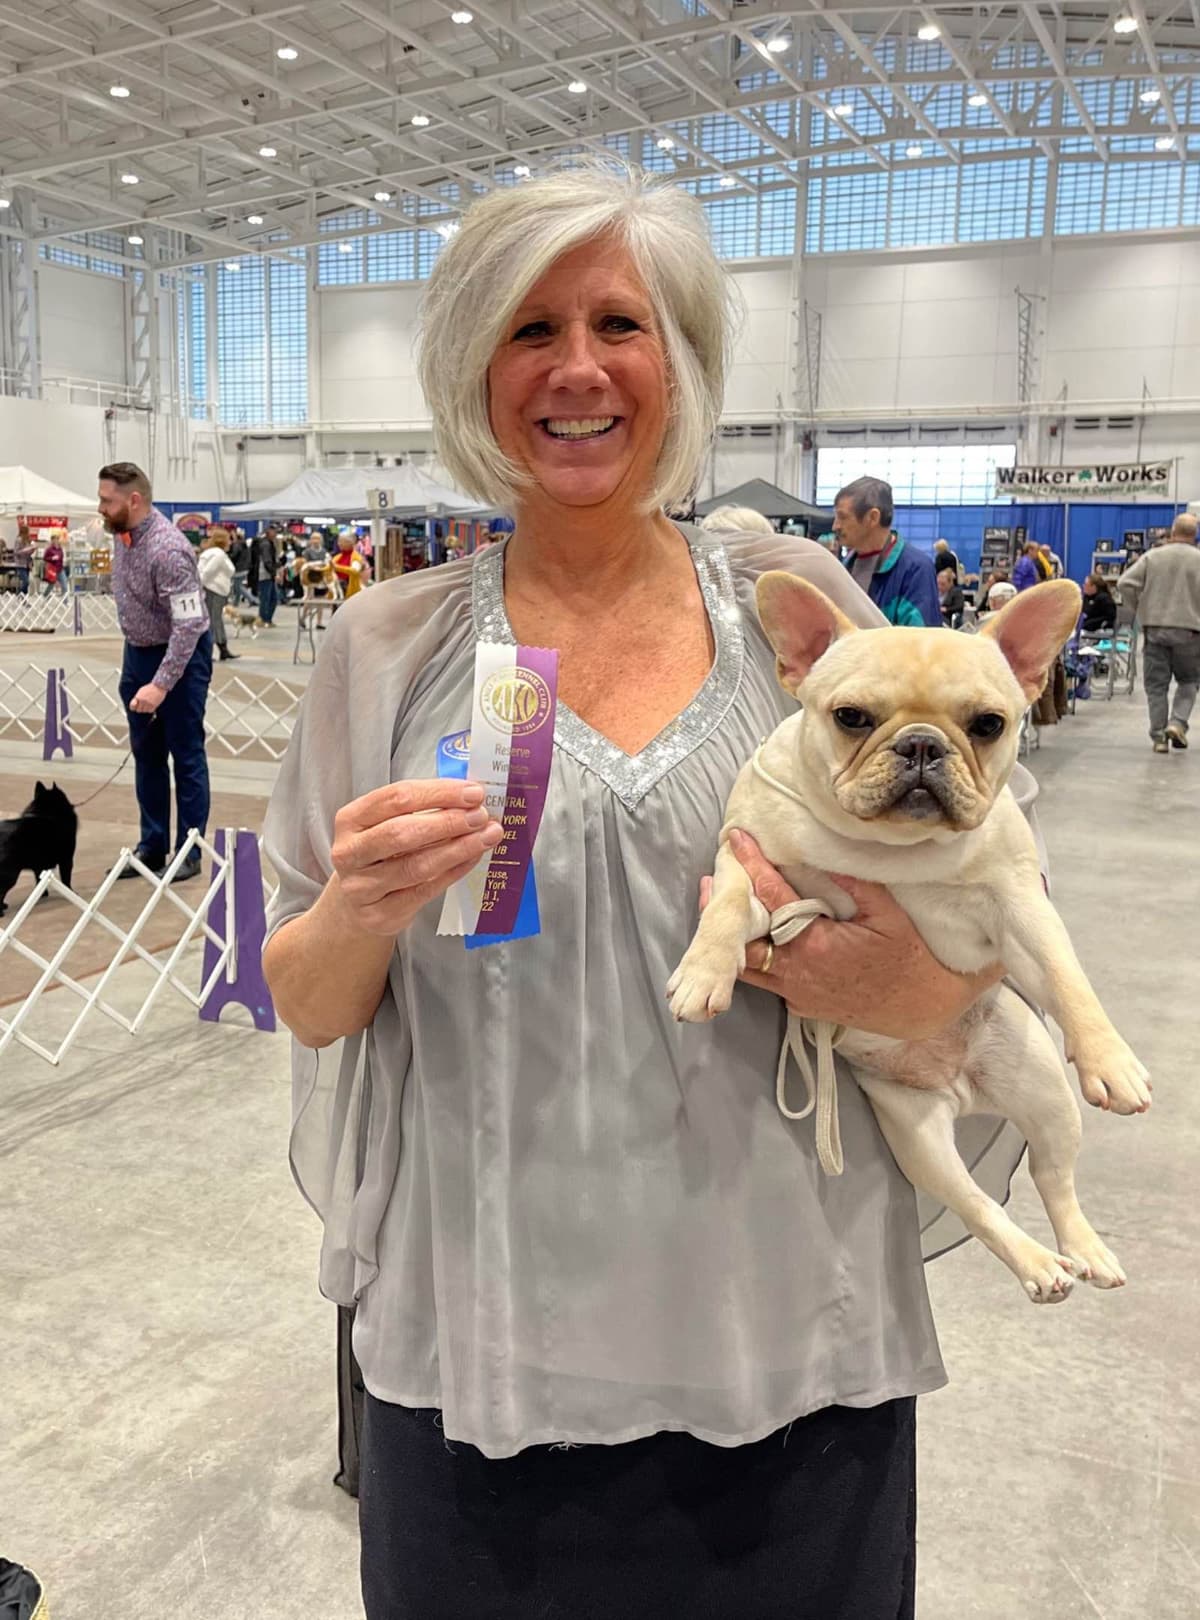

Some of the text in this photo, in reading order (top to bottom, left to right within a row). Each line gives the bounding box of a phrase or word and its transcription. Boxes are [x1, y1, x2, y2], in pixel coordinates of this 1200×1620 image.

[999, 463, 1167, 484] Walker Works
[379, 491, 388, 508] 8
[180, 598, 196, 612] 11
[492, 682, 540, 723] AKC
[485, 794, 527, 809] CENTRAL
[503, 815, 528, 825] YORK
[494, 845, 508, 855] UB
[487, 870, 509, 881] cuse,
[487, 879, 507, 890] York
[481, 901, 495, 912] 22
